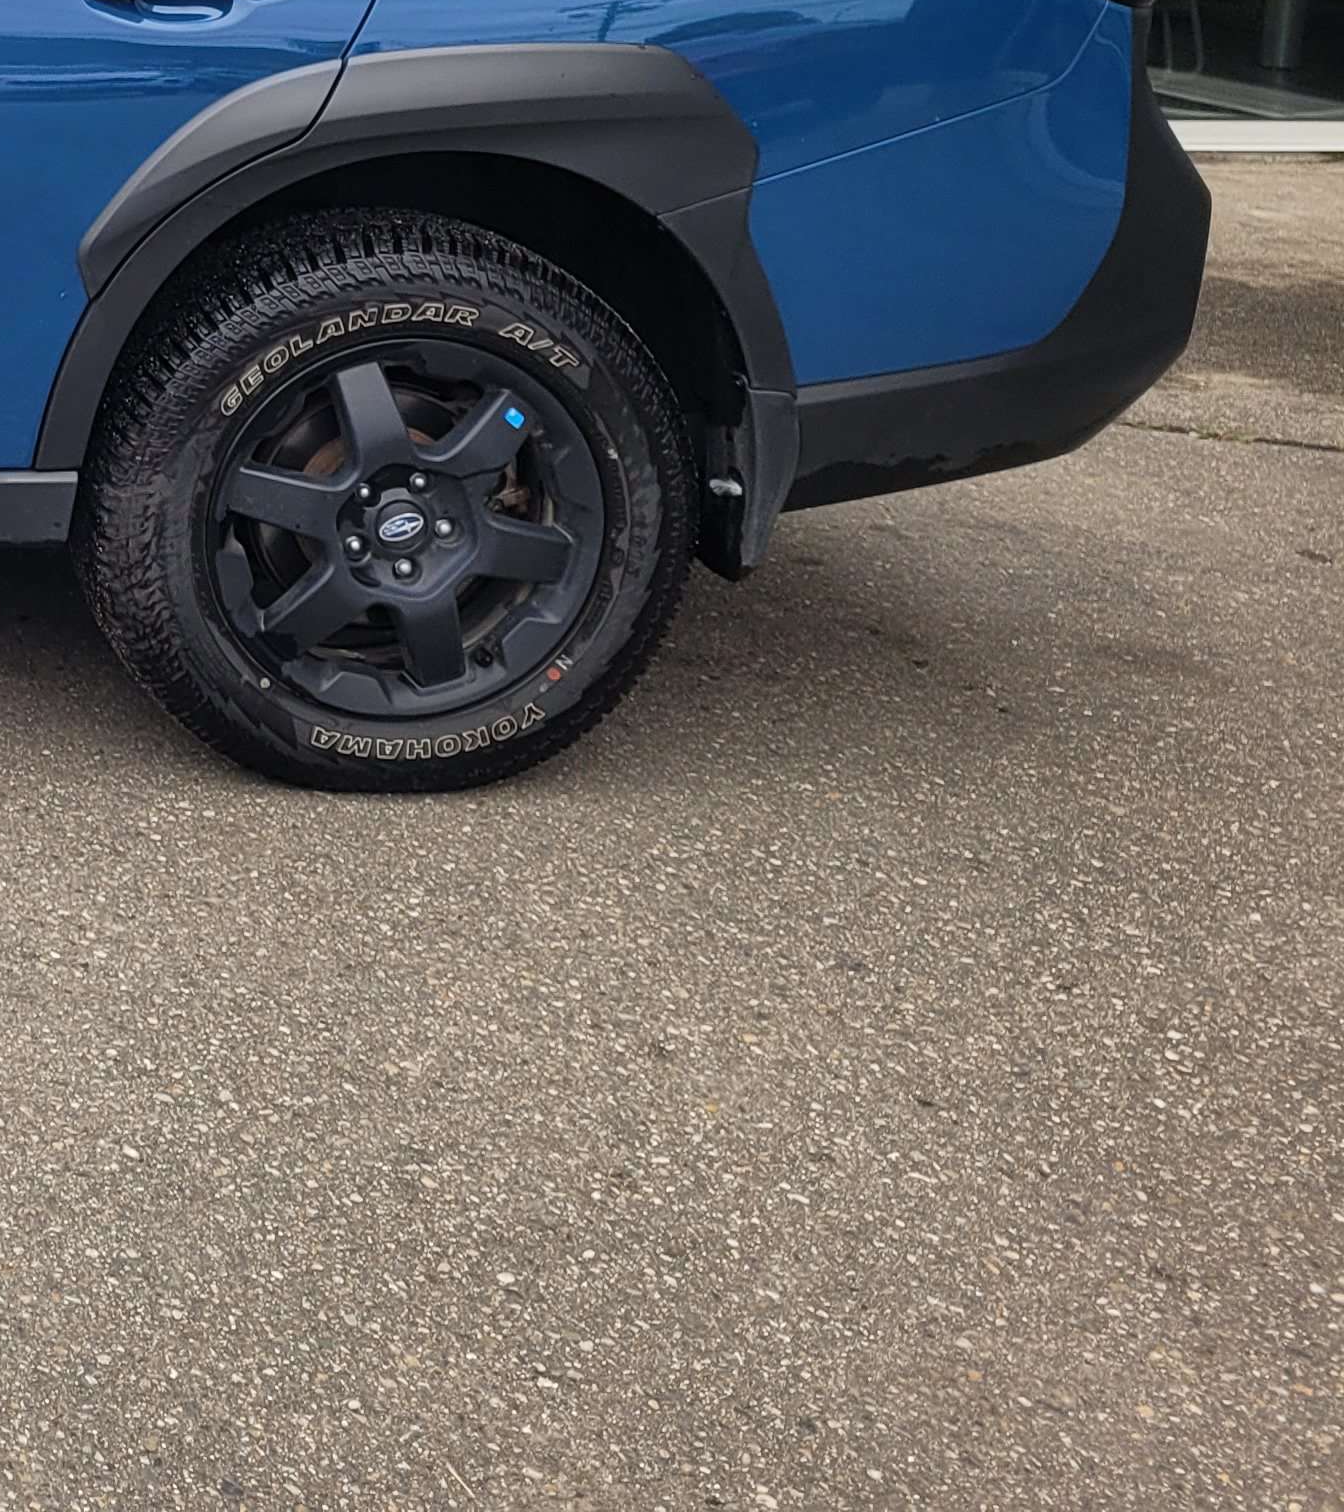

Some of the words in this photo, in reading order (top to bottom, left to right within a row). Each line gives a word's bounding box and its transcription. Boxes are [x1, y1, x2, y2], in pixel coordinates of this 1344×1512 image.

[219, 302, 480, 417] GEOLANDAR
[498, 320, 580, 370] A/T
[310, 701, 546, 760] YOKOHAMA
